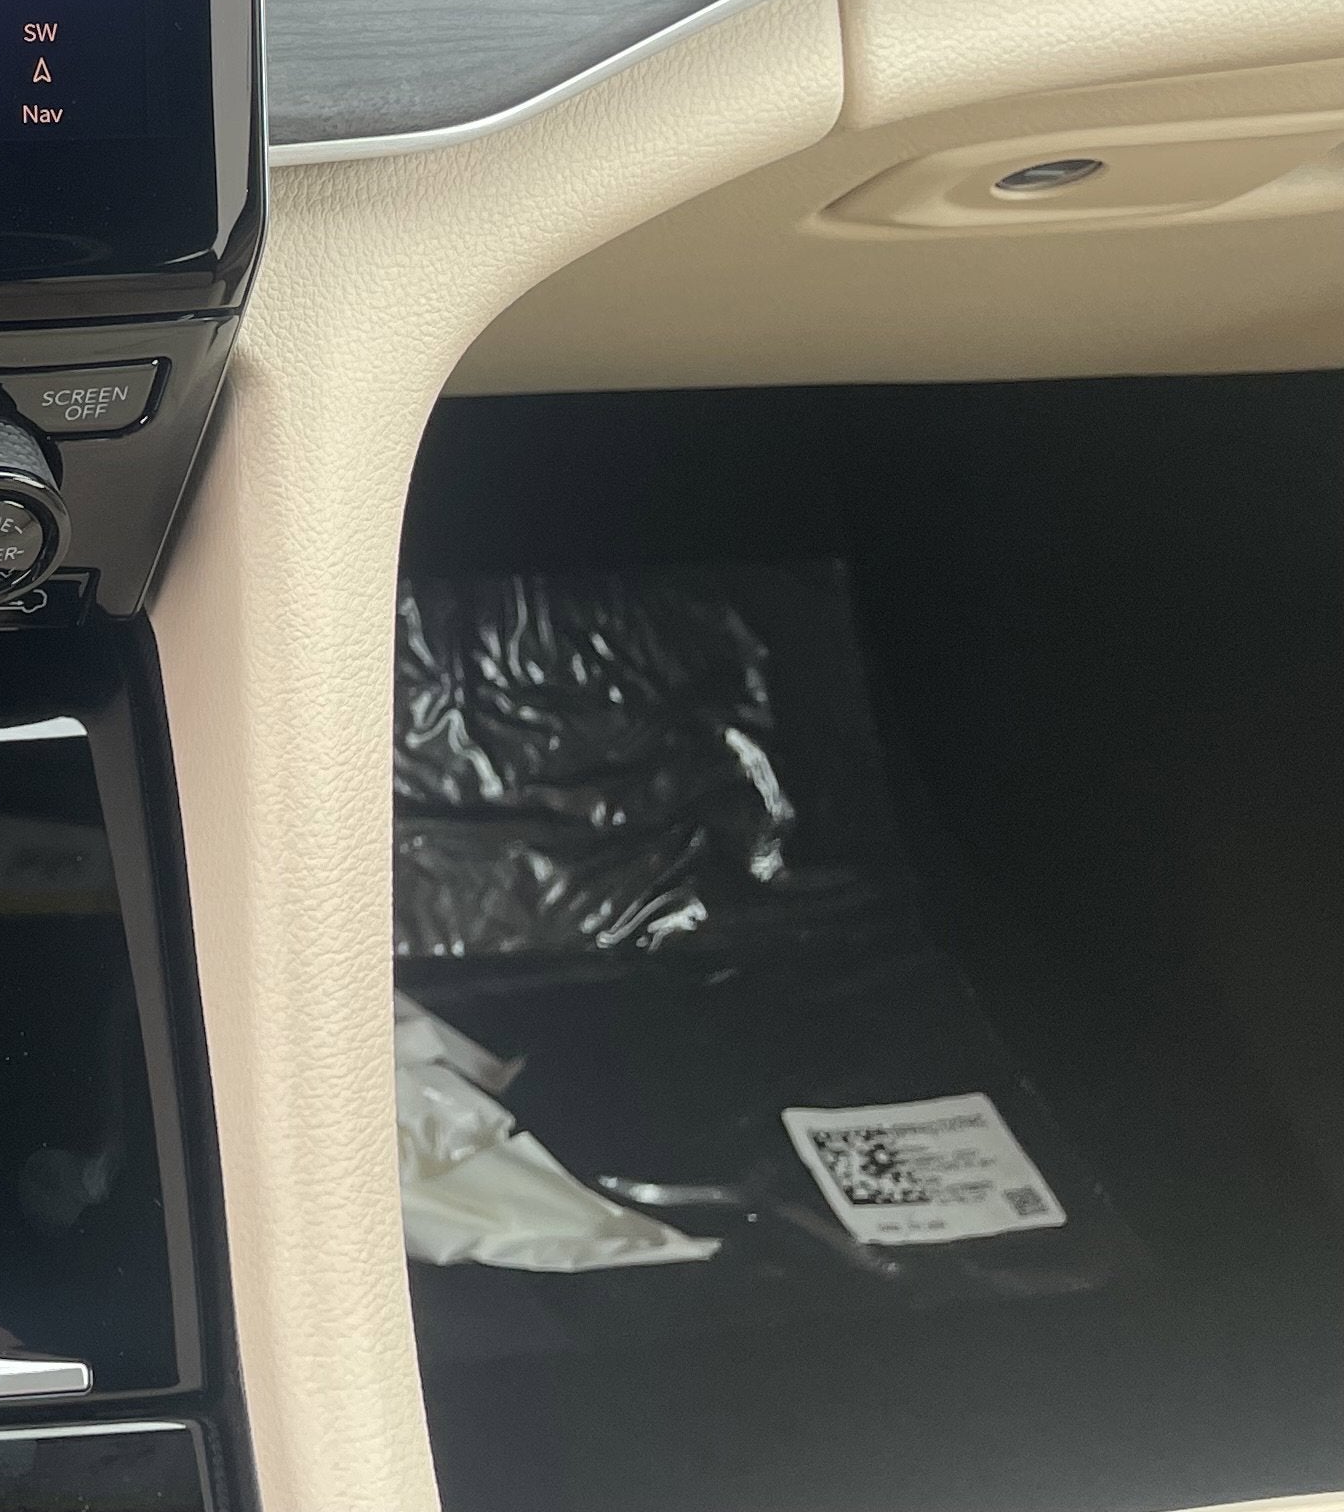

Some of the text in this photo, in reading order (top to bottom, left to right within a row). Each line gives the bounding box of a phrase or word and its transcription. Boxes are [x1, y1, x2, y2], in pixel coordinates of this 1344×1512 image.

[23, 23, 58, 42] SW
[22, 104, 64, 124] Nav
[41, 385, 129, 407] SCREEN
[64, 403, 109, 421] OFF
